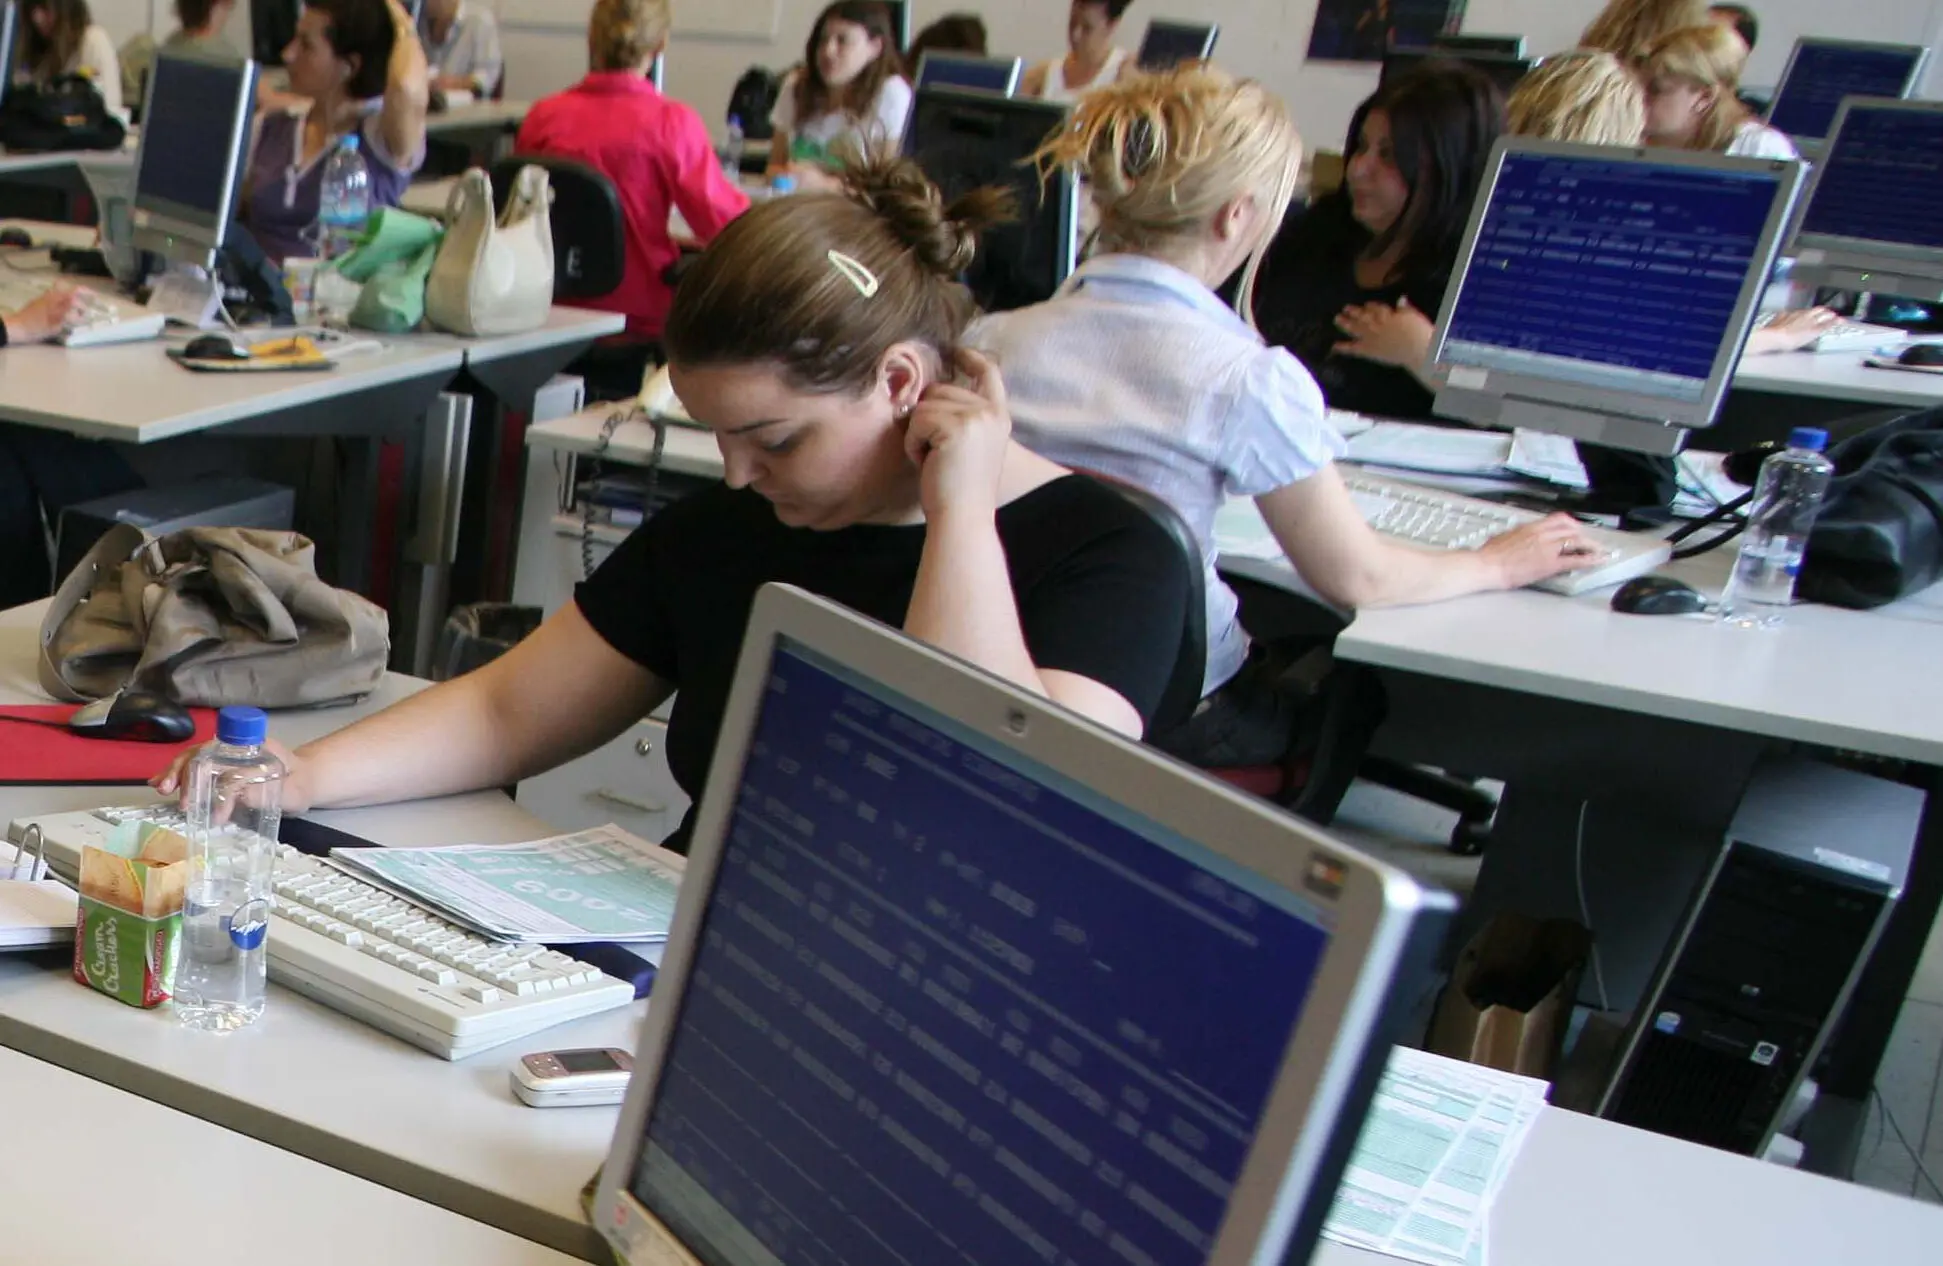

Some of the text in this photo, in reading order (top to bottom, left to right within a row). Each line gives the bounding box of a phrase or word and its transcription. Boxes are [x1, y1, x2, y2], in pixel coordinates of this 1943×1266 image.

[513, 880, 655, 922] 2009
[91, 922, 105, 975] Cream
[104, 916, 119, 993] Crackers
